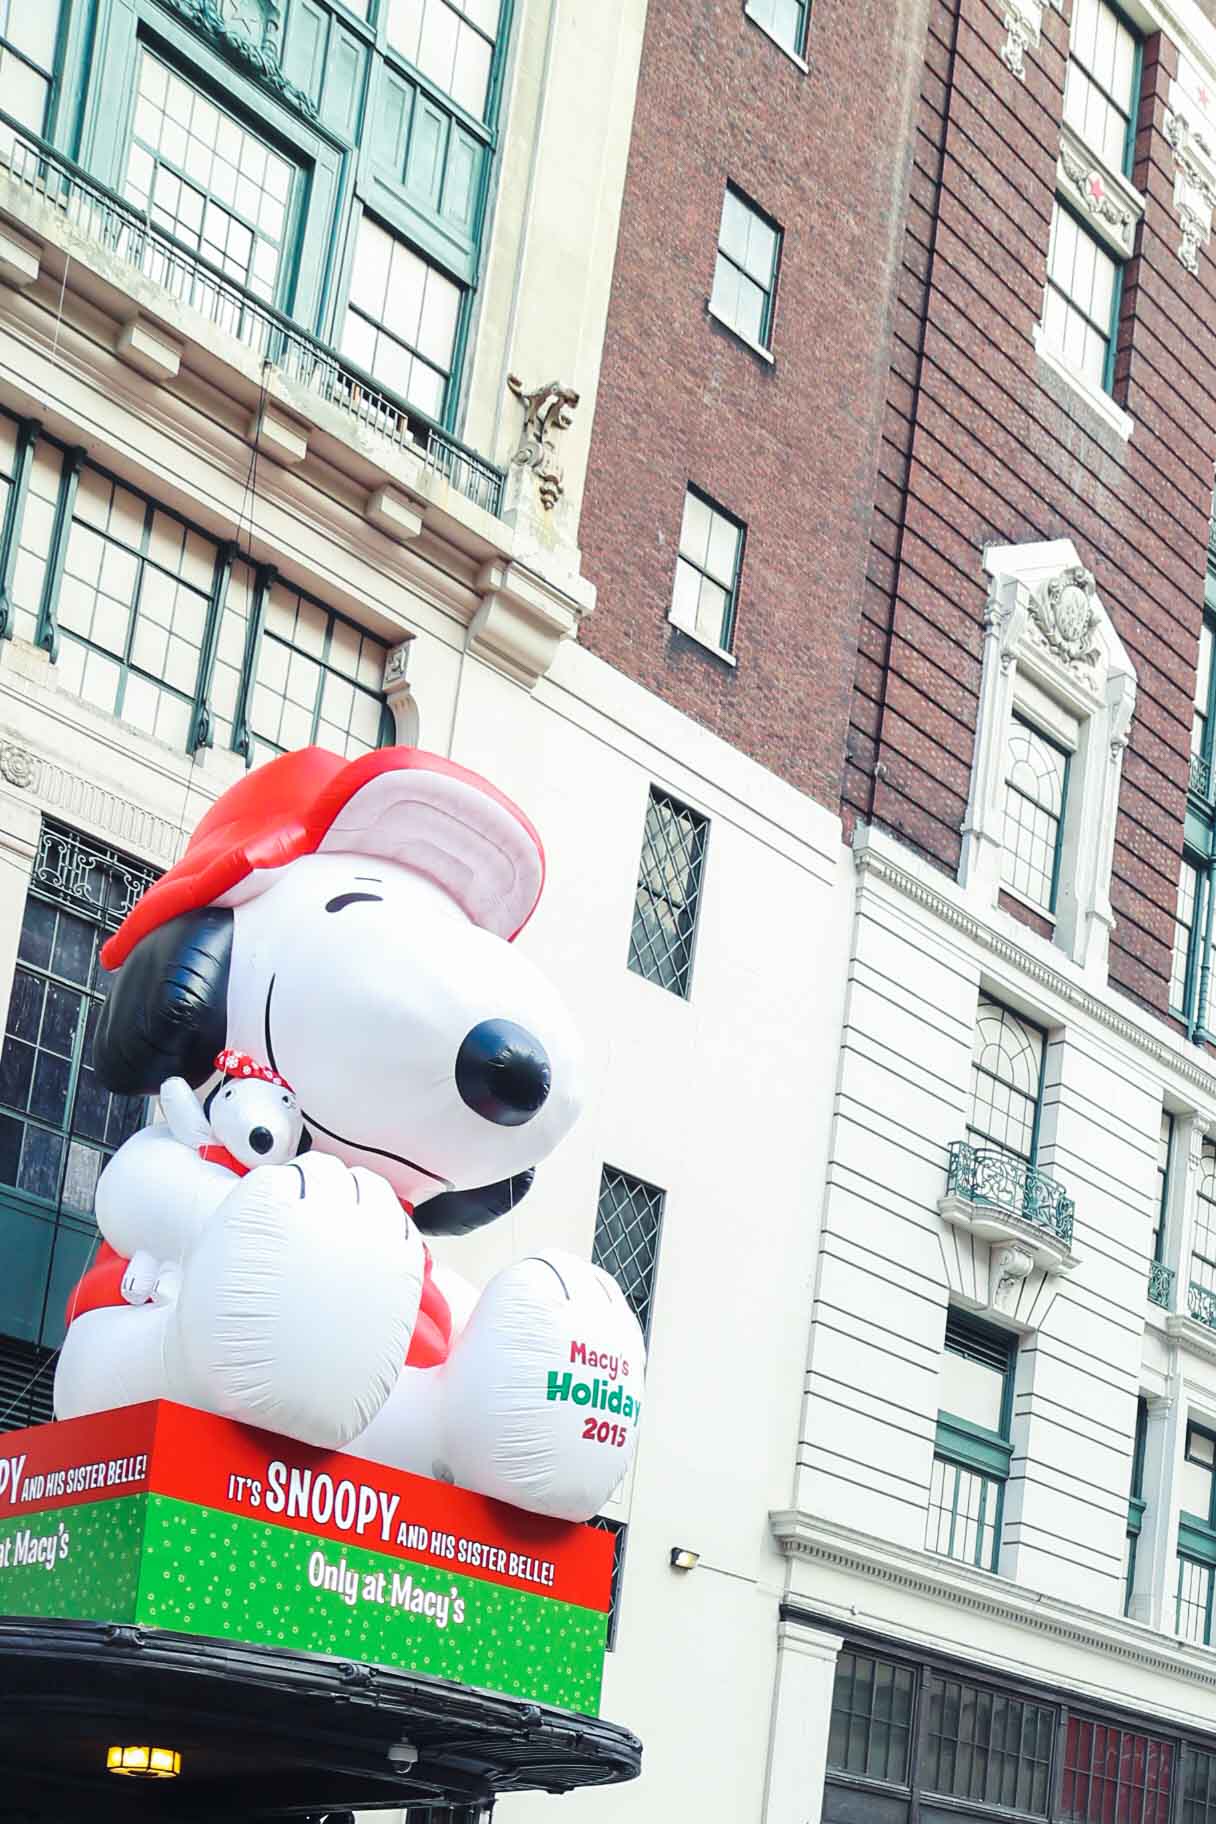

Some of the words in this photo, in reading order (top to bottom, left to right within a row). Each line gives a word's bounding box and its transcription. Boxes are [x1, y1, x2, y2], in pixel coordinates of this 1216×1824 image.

[569, 1340, 630, 1381] Macy's
[546, 1371, 641, 1428] Holiday
[582, 1417, 628, 1448] 2015
[20, 1475, 46, 1503] AND
[45, 1470, 66, 1498] HIS
[65, 1462, 107, 1494] SISTER
[106, 1454, 148, 1486] BELLE!
[13, 1521, 70, 1571] Macy's
[227, 1474, 263, 1507] IT'S
[264, 1460, 401, 1542] SNOOPY
[396, 1521, 428, 1551] AND
[429, 1530, 456, 1560] HIS
[457, 1538, 507, 1575] SISTER
[507, 1551, 556, 1587] BELLE!
[308, 1550, 359, 1606] Only
[361, 1571, 387, 1604] at
[389, 1572, 466, 1629] Macy's
